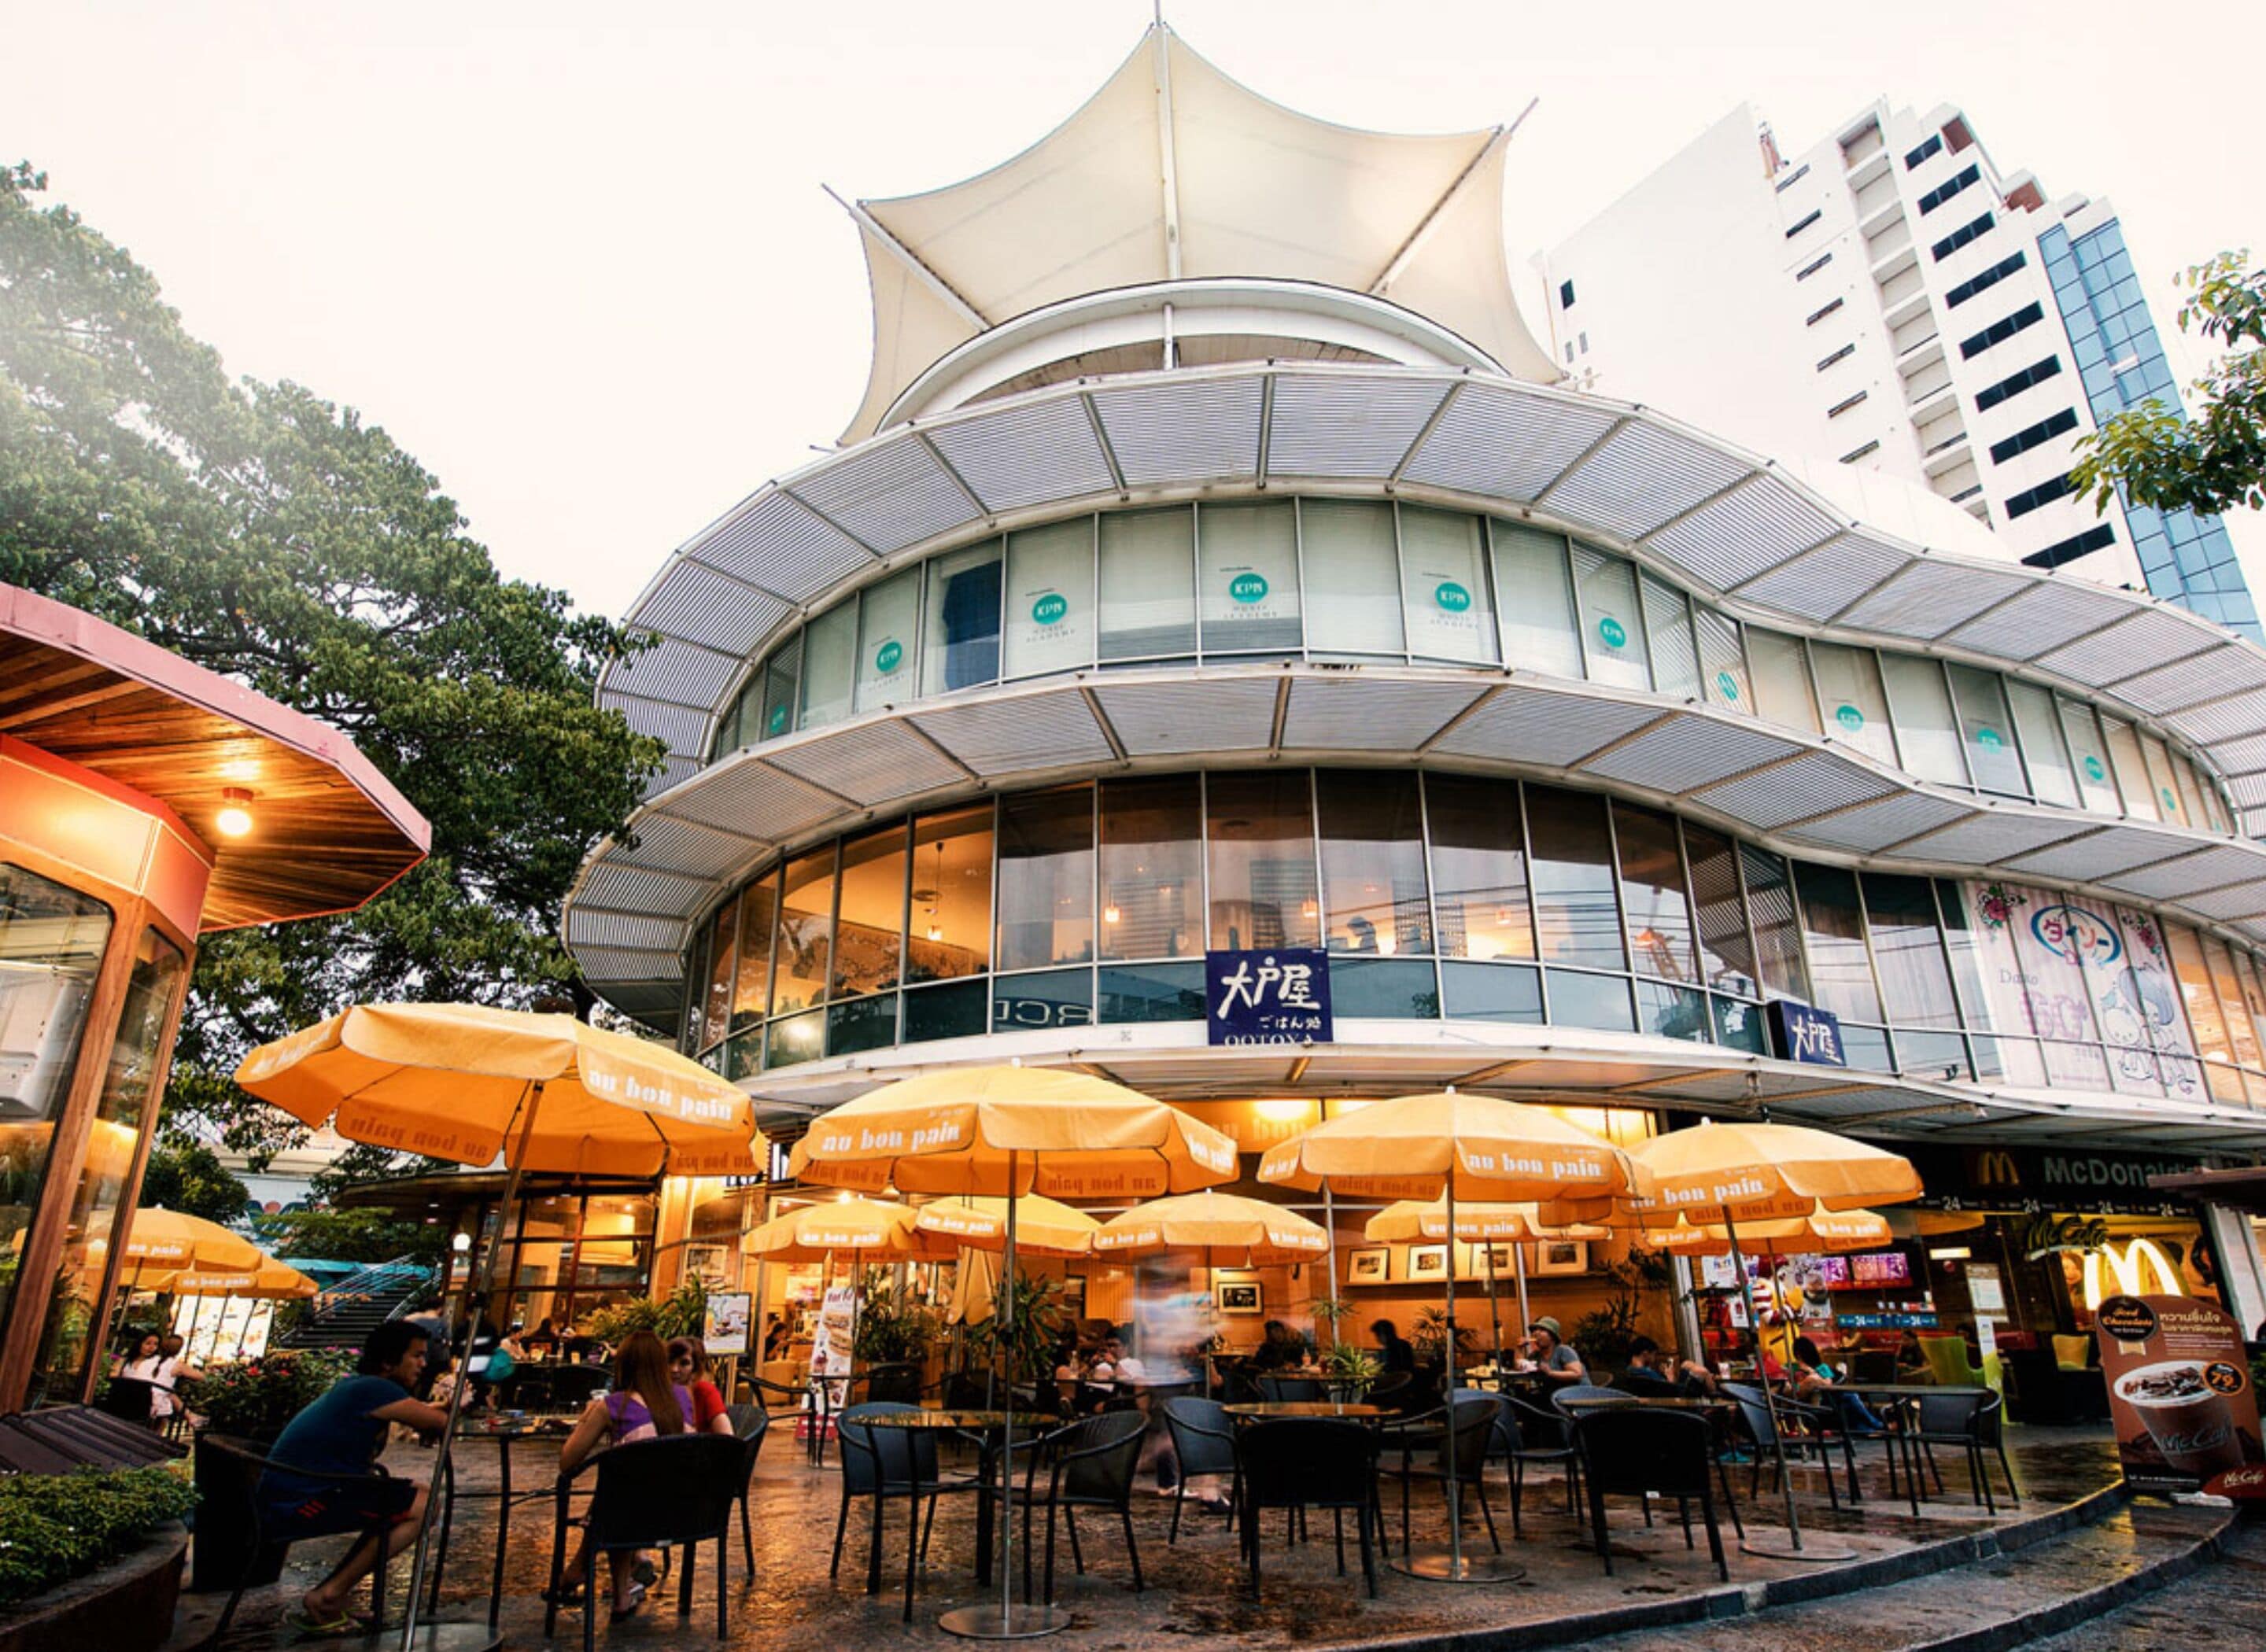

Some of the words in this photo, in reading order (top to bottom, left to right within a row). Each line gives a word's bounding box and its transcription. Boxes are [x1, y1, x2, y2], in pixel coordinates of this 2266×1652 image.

[1234, 583, 1263, 594] KPN
[1441, 591, 1467, 605] KPN
[1038, 602, 1063, 617] KPN
[1216, 955, 1321, 1020] 大戸屋
[1791, 1013, 1842, 1064] 大戸屋
[589, 1069, 617, 1093] au
[626, 1076, 672, 1106] bon
[680, 1095, 733, 1120] pain
[821, 1135, 852, 1152] au
[861, 1128, 902, 1150] bon
[911, 1120, 960, 1152] pain
[1470, 1154, 1494, 1170] au
[1502, 1152, 1544, 1174] bon
[1552, 1158, 1601, 1179] pain
[2043, 1156, 2195, 1187] McDonal
[1663, 1187, 1706, 1205] bon
[1714, 1178, 1763, 1202] pain
[1942, 1196, 1962, 1211] 24
[2023, 1197, 2040, 1214] 24
[1483, 1221, 1515, 1237] pain
[2212, 1373, 2235, 1387] 79
